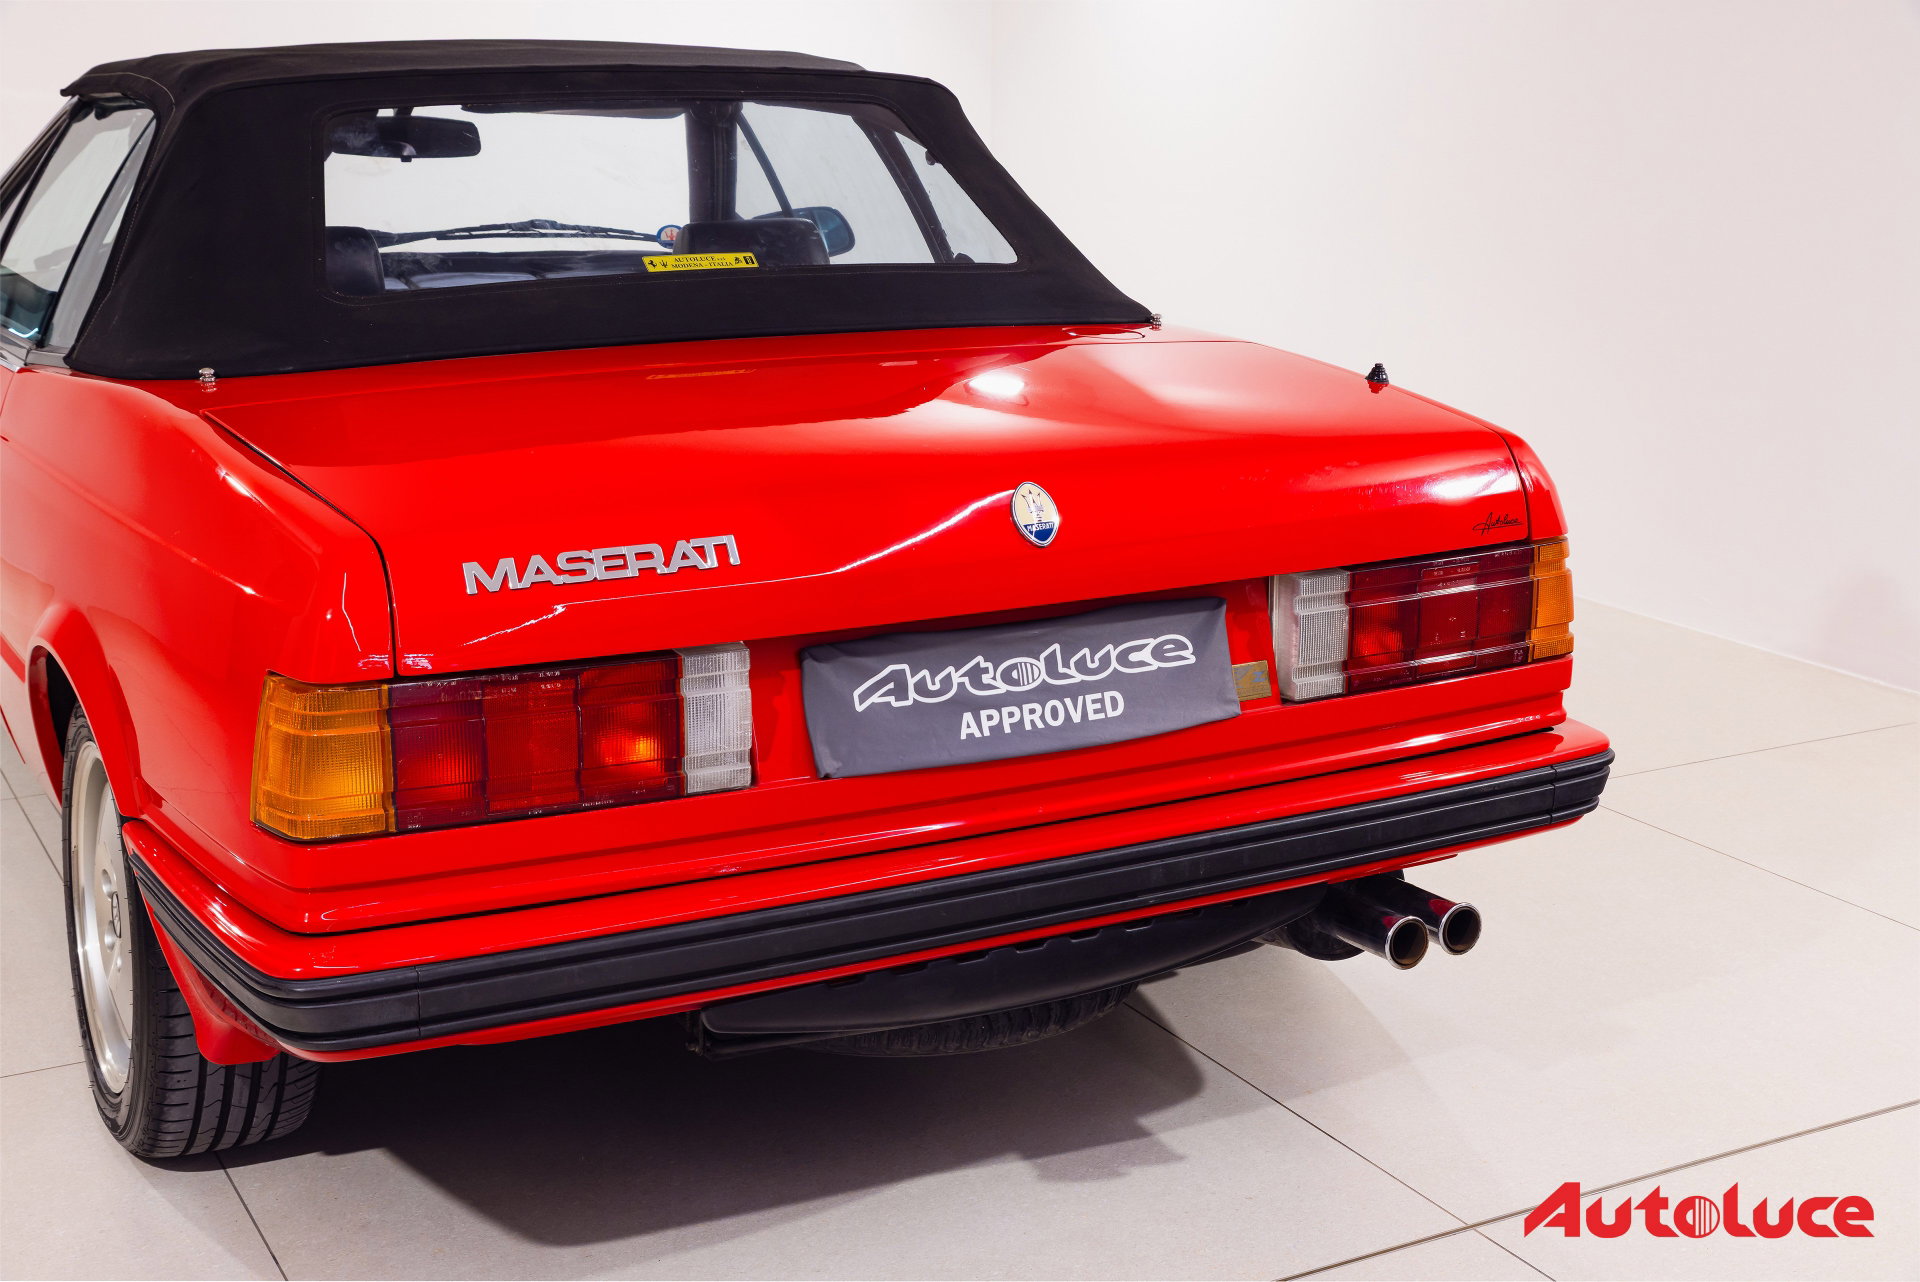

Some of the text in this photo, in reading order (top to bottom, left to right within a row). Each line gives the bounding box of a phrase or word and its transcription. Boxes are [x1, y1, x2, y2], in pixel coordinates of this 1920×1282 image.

[1026, 522, 1054, 532] MASERATI
[462, 534, 741, 595] MASERATI
[853, 633, 1196, 713] Autoluce
[960, 690, 1125, 741] APPROVED
